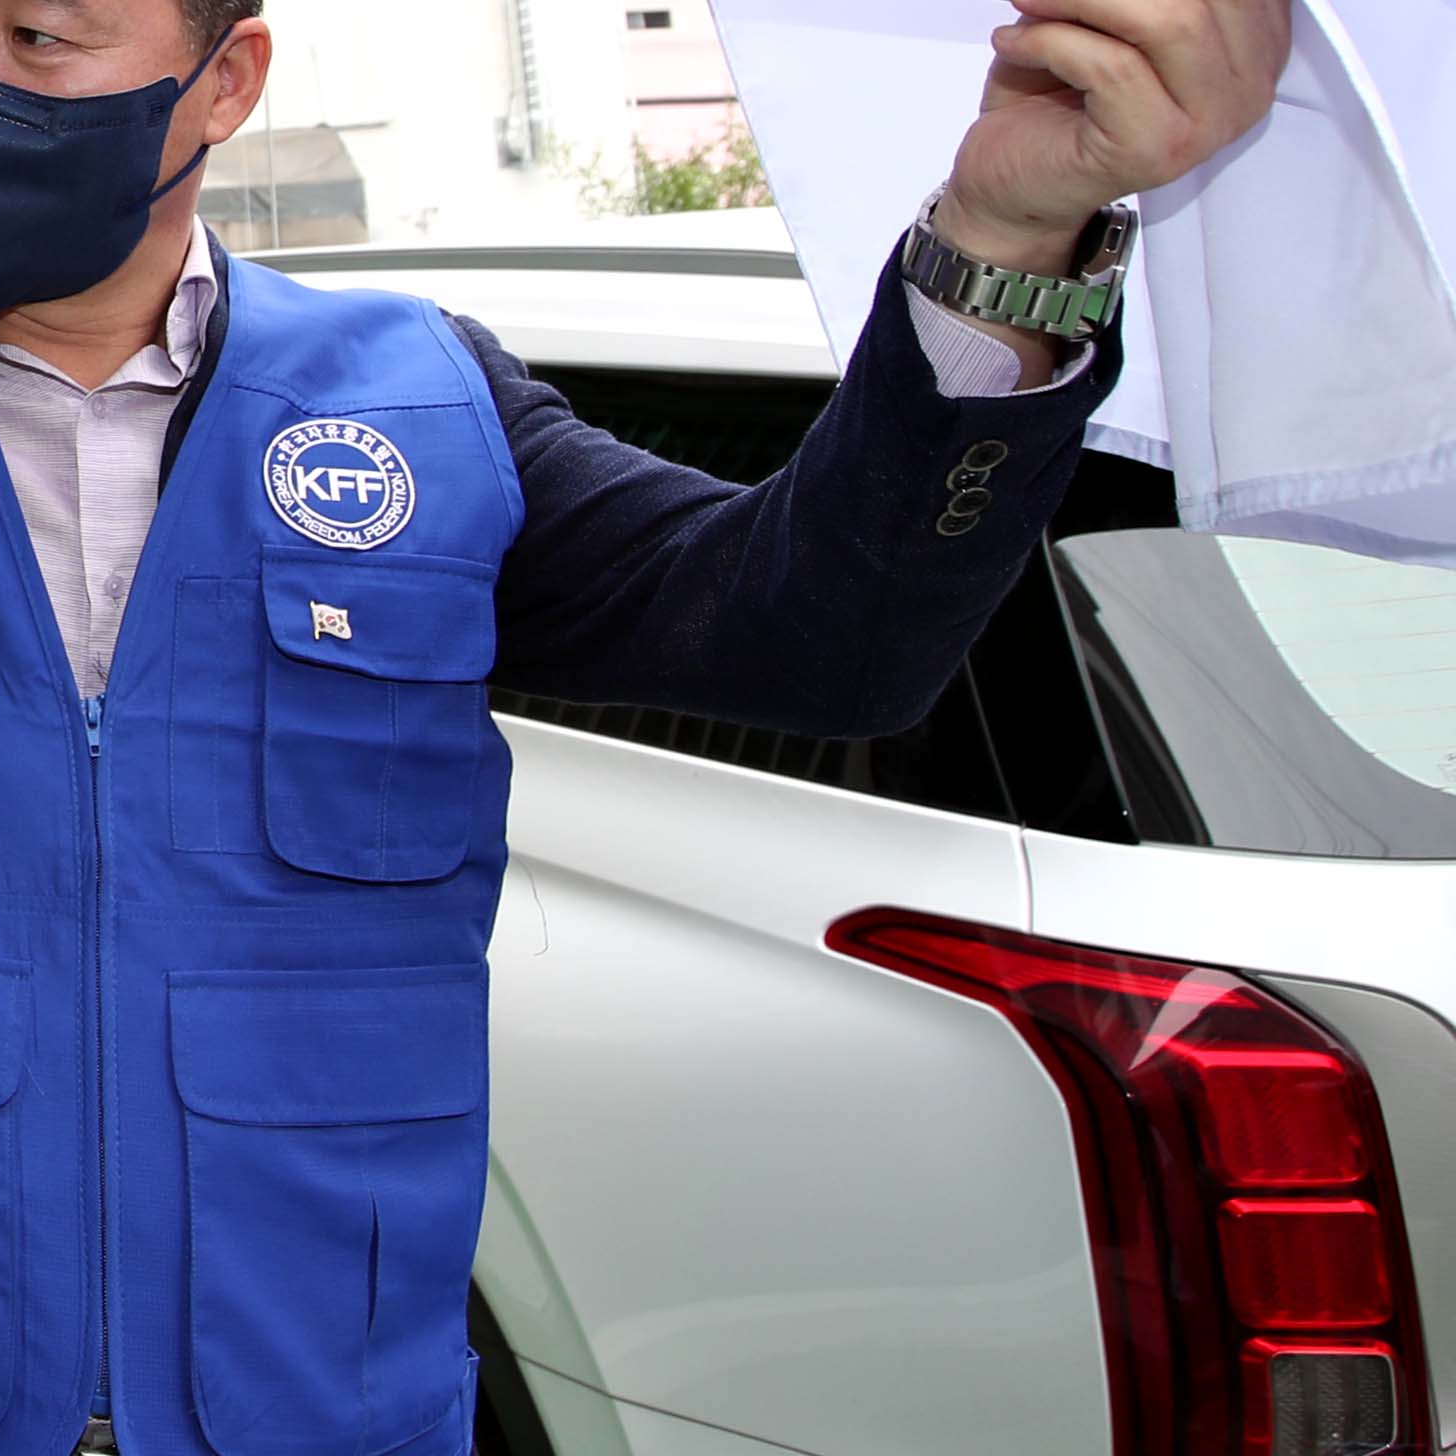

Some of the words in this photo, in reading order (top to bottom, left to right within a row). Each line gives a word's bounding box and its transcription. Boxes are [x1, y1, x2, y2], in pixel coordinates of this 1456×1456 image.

[278, 424, 392, 462] 한국자유총연맹
[272, 464, 295, 511] KOREA
[291, 509, 363, 543] FREEDOM
[362, 472, 407, 541] FEDERATION
[293, 465, 384, 504] KFF
